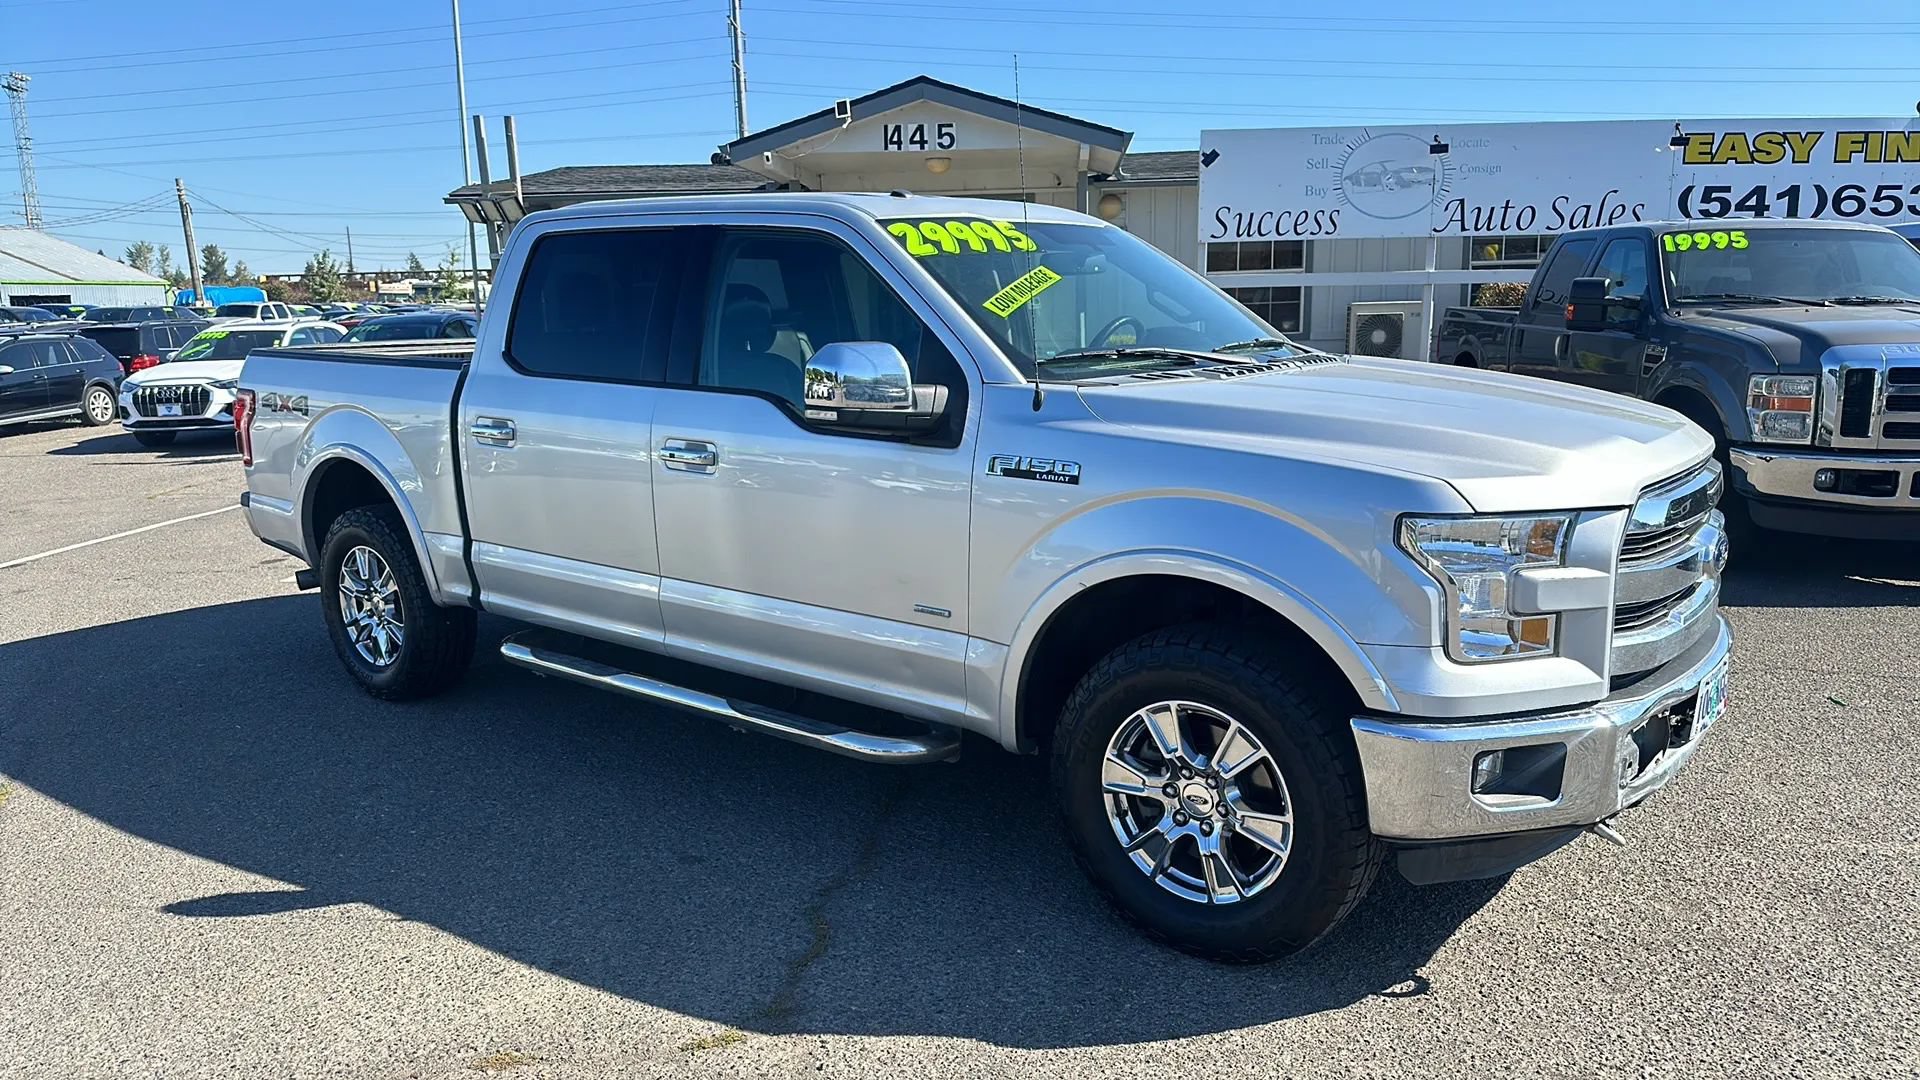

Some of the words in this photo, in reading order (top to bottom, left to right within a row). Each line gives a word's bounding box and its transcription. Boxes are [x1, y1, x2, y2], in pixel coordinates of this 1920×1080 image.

[883, 123, 956, 151] 1445
[1311, 132, 1345, 145] Trade
[1450, 137, 1490, 149] Locate
[1683, 131, 1824, 165] EASY
[1306, 158, 1329, 170] Sell
[1459, 163, 1502, 176] Consign
[1305, 185, 1329, 200] Buy
[1210, 206, 1340, 239] Success
[1432, 198, 1537, 233] Auto
[1545, 189, 1645, 231] Sales
[886, 220, 1038, 258] 29995
[1662, 230, 1749, 253] 19995
[989, 290, 1018, 313] LOW
[1009, 269, 1053, 299] MILEAGE
[985, 454, 1081, 478] F150
[1036, 472, 1070, 483] LARIAT
